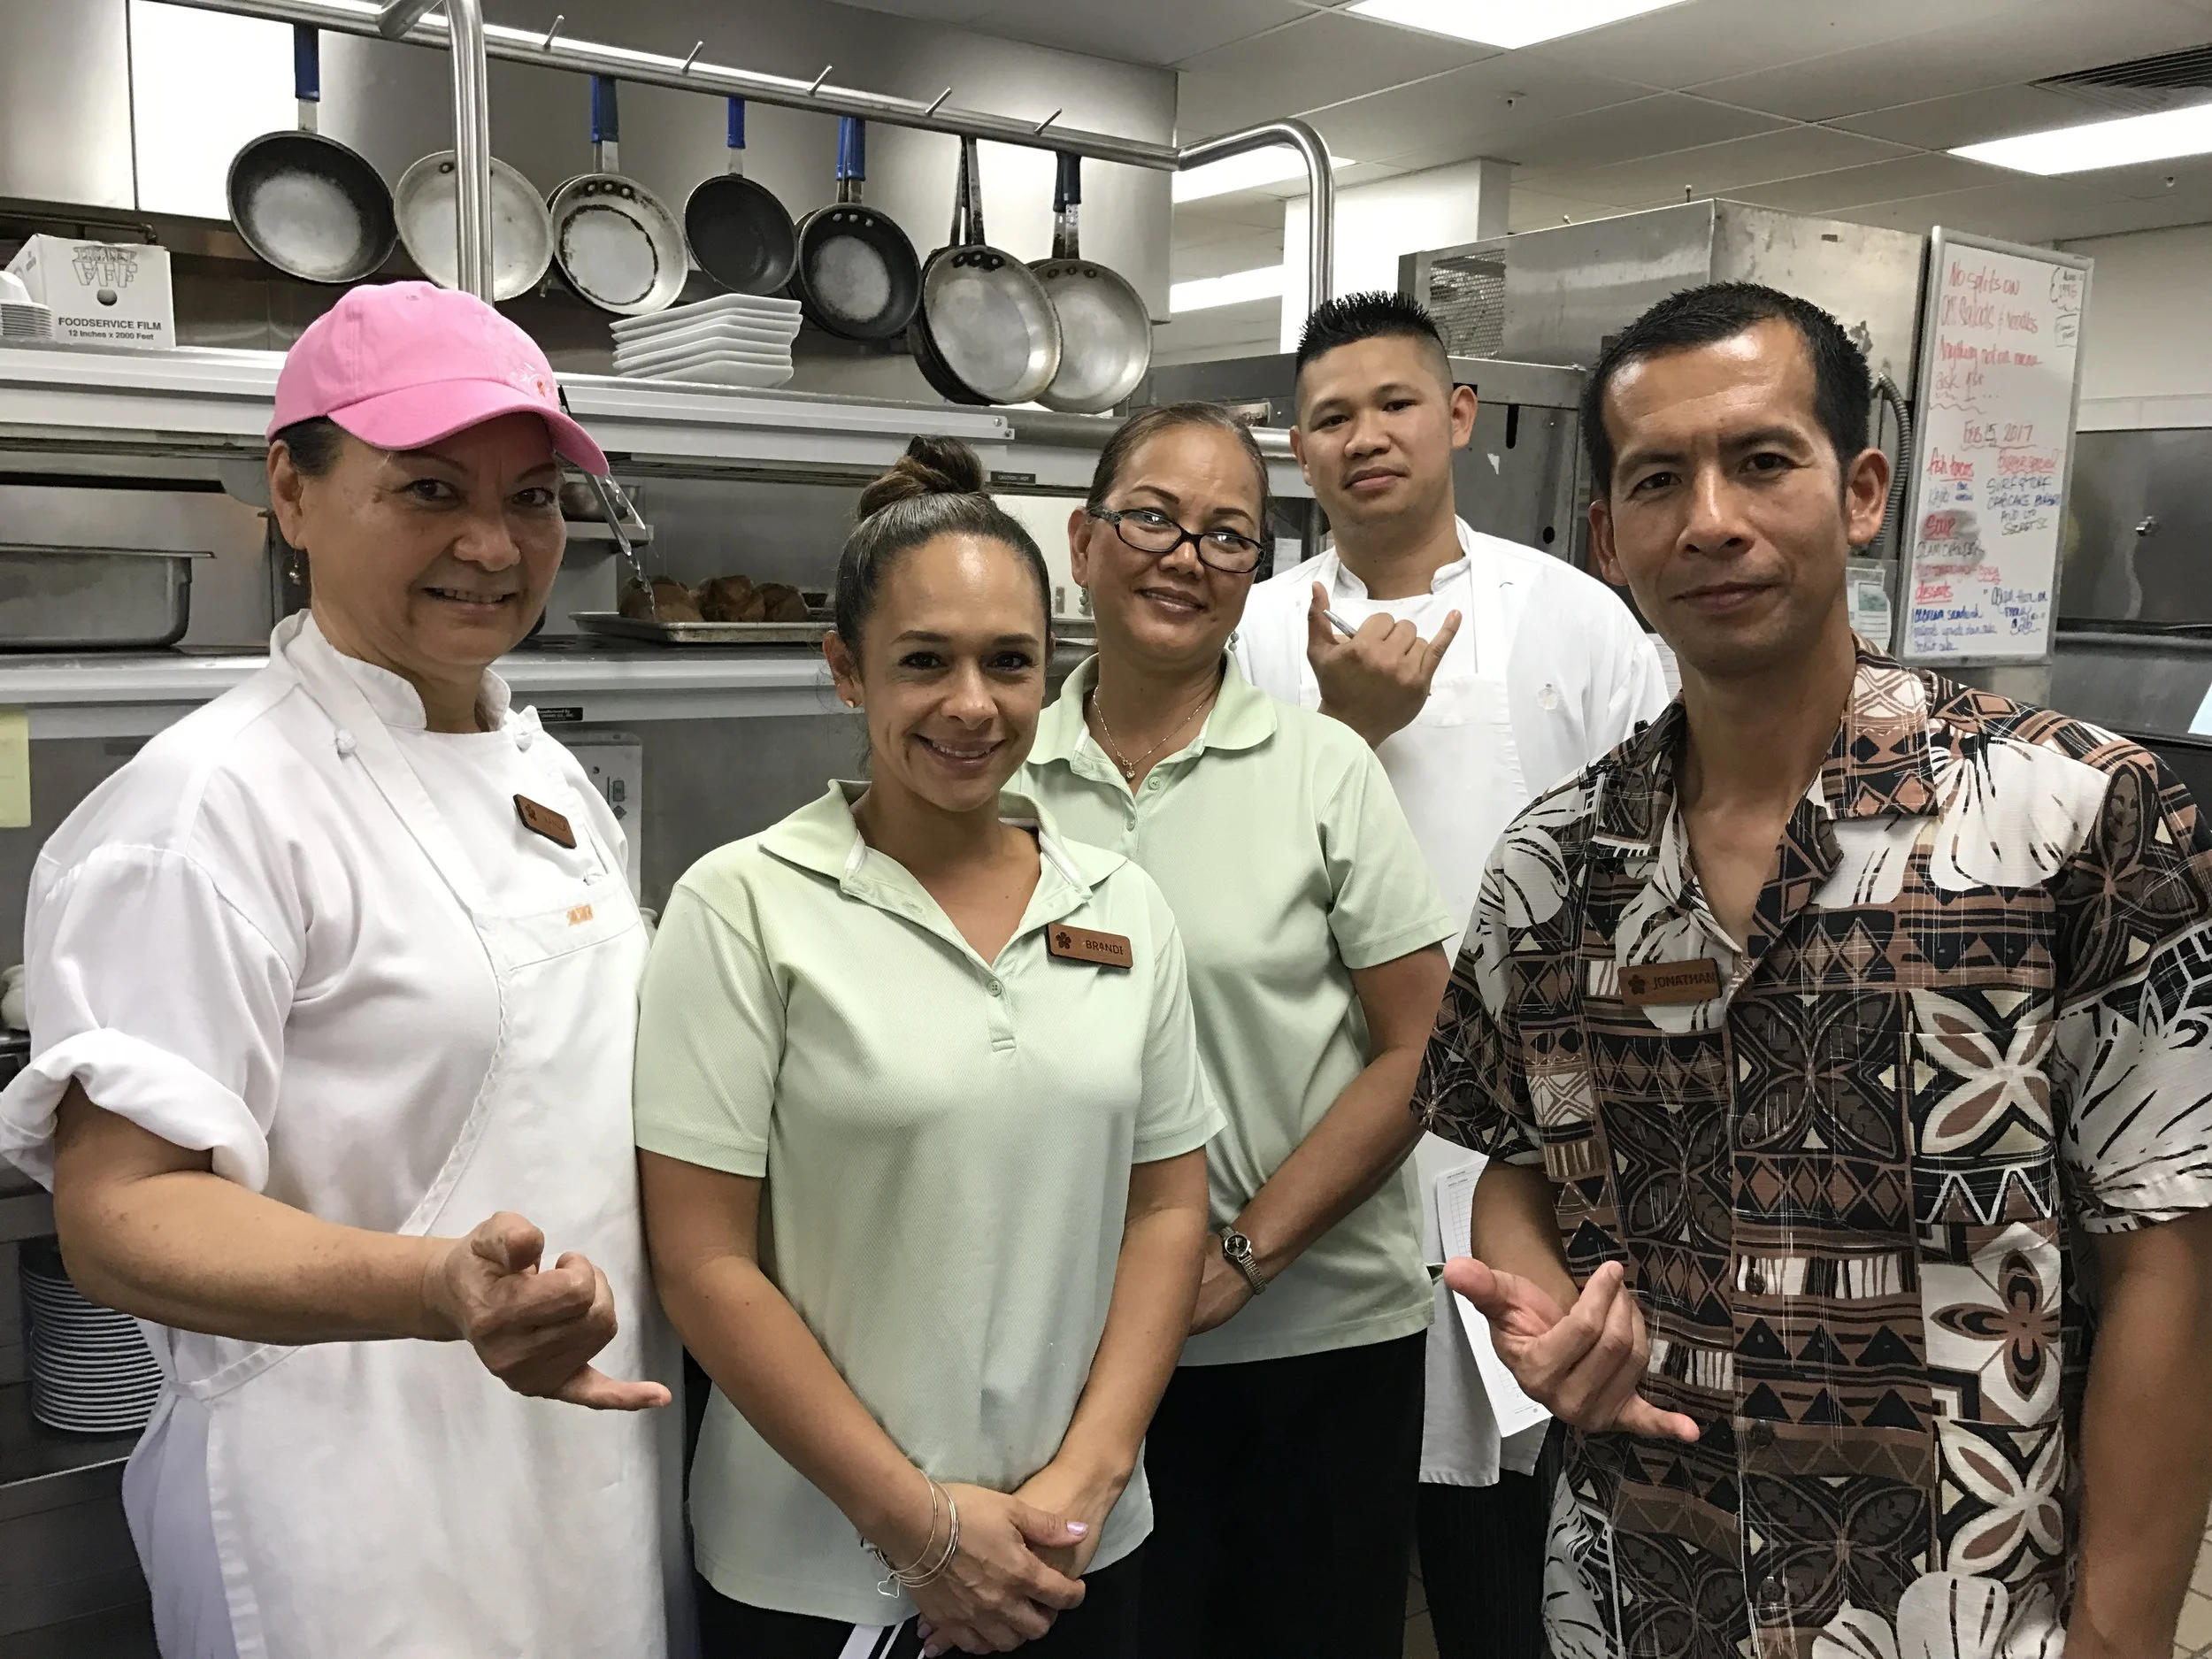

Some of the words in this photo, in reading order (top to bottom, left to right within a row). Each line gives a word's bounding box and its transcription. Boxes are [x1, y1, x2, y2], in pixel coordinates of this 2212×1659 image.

[58, 317, 134, 329] FOODSERVICE
[137, 321, 162, 331] FILM
[80, 330, 107, 339] Inches
[115, 331, 134, 340] 2000
[2003, 423, 2033, 442] 2017
[1085, 940, 1124, 956] BRANDI
[1652, 972, 1717, 990] JONATHAN
